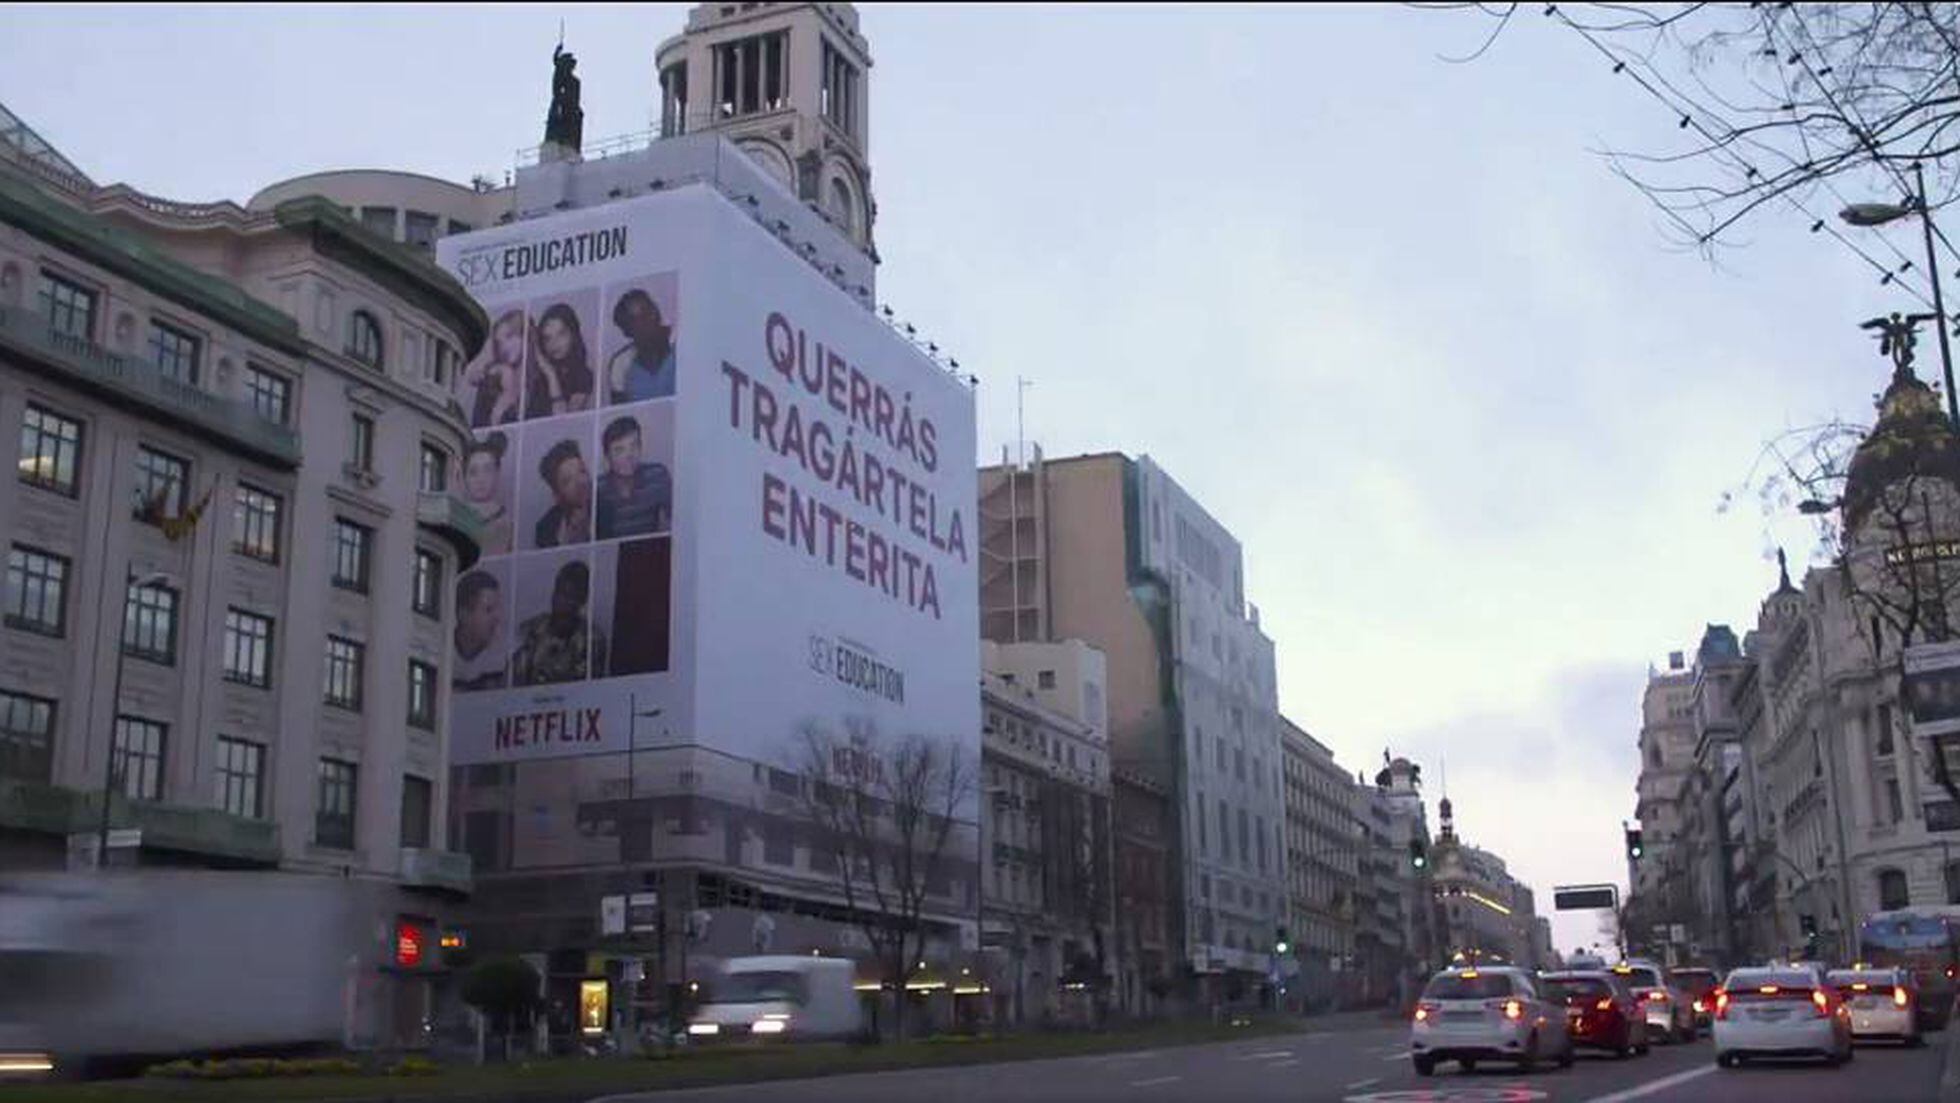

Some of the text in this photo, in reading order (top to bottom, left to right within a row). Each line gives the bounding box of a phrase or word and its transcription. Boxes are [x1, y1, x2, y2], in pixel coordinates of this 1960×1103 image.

[458, 226, 628, 286] SEX EDUCATION
[766, 311, 937, 473] QUERRÁS
[722, 360, 968, 563] TRAGÁRTELA
[763, 472, 942, 620] ENTERITA
[837, 646, 904, 704] EDUCATION
[495, 708, 601, 751] NETFLIX
